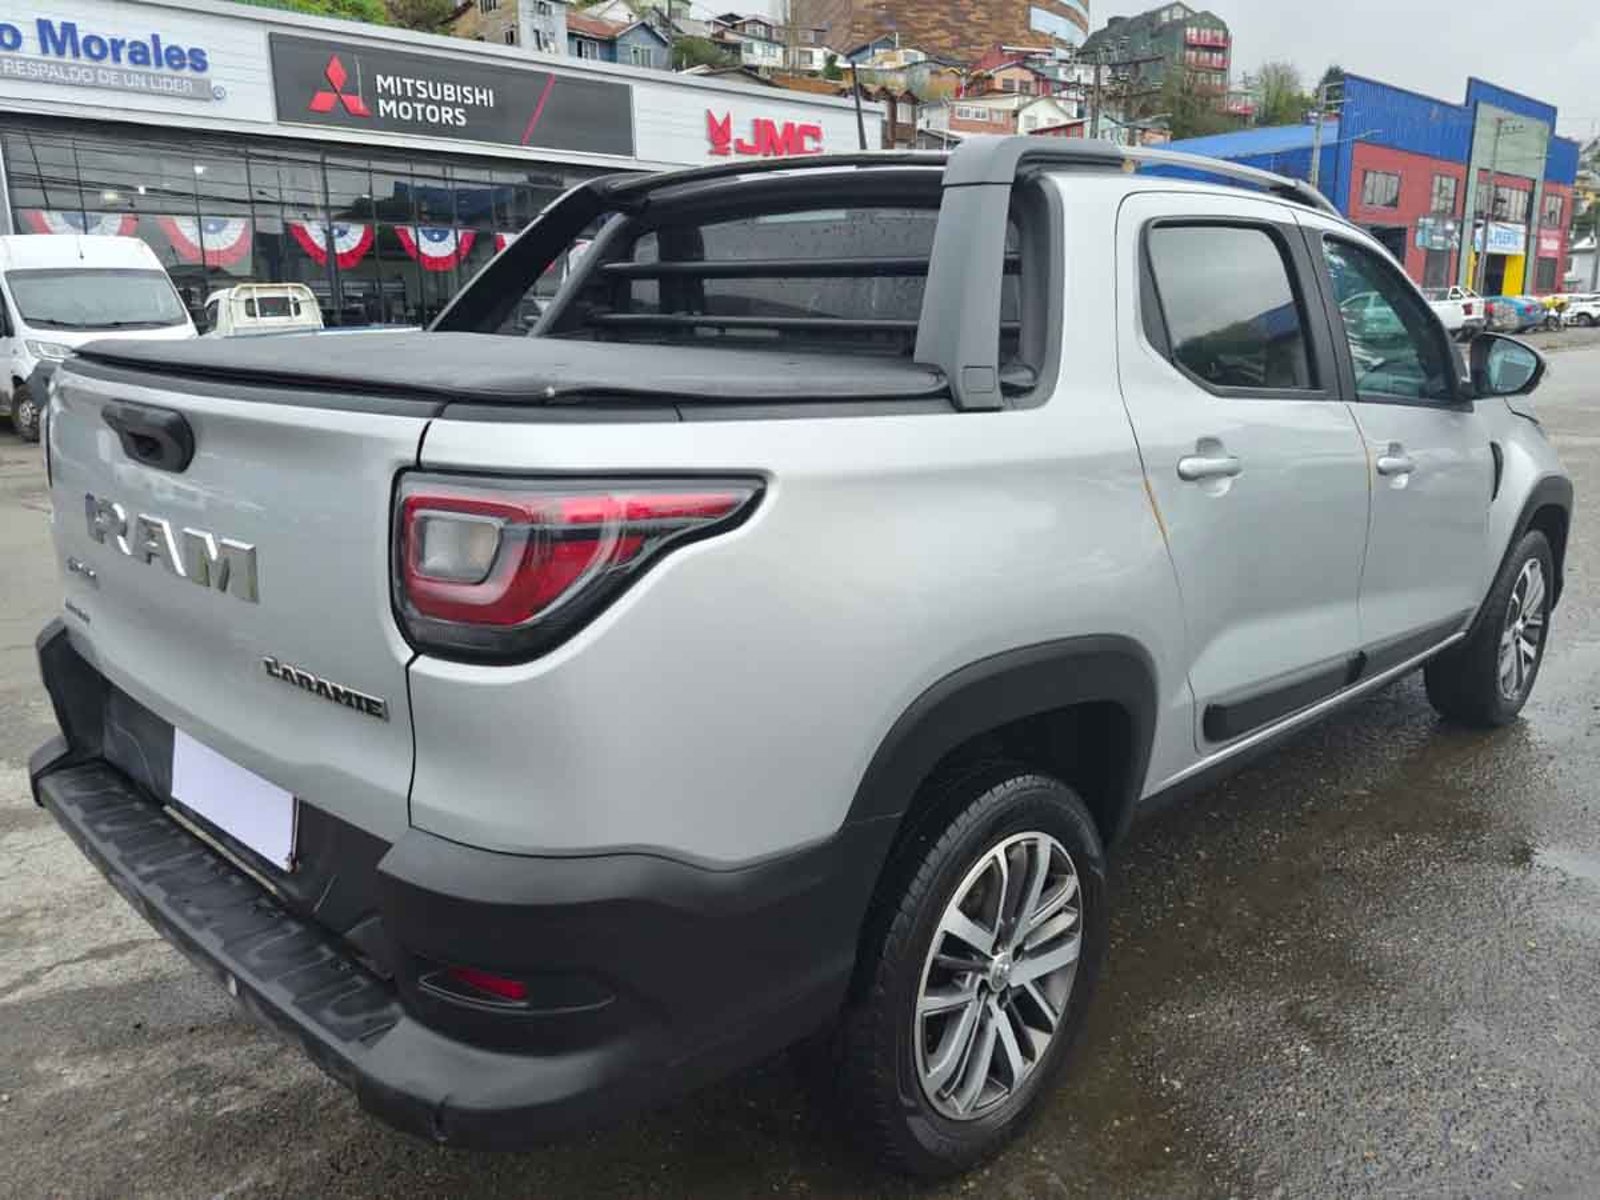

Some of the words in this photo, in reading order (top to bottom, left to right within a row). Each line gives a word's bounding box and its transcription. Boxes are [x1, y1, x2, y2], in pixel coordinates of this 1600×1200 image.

[36, 18, 209, 72] Morales
[3, 58, 95, 83] RESPALDO
[98, 69, 119, 86] DE
[124, 73, 146, 88] UN
[376, 74, 494, 108] MITSUBISHI
[378, 98, 467, 126] MOTORS
[735, 118, 824, 156] JMC
[85, 493, 259, 603] RAM
[263, 656, 390, 722] LARAMIE
